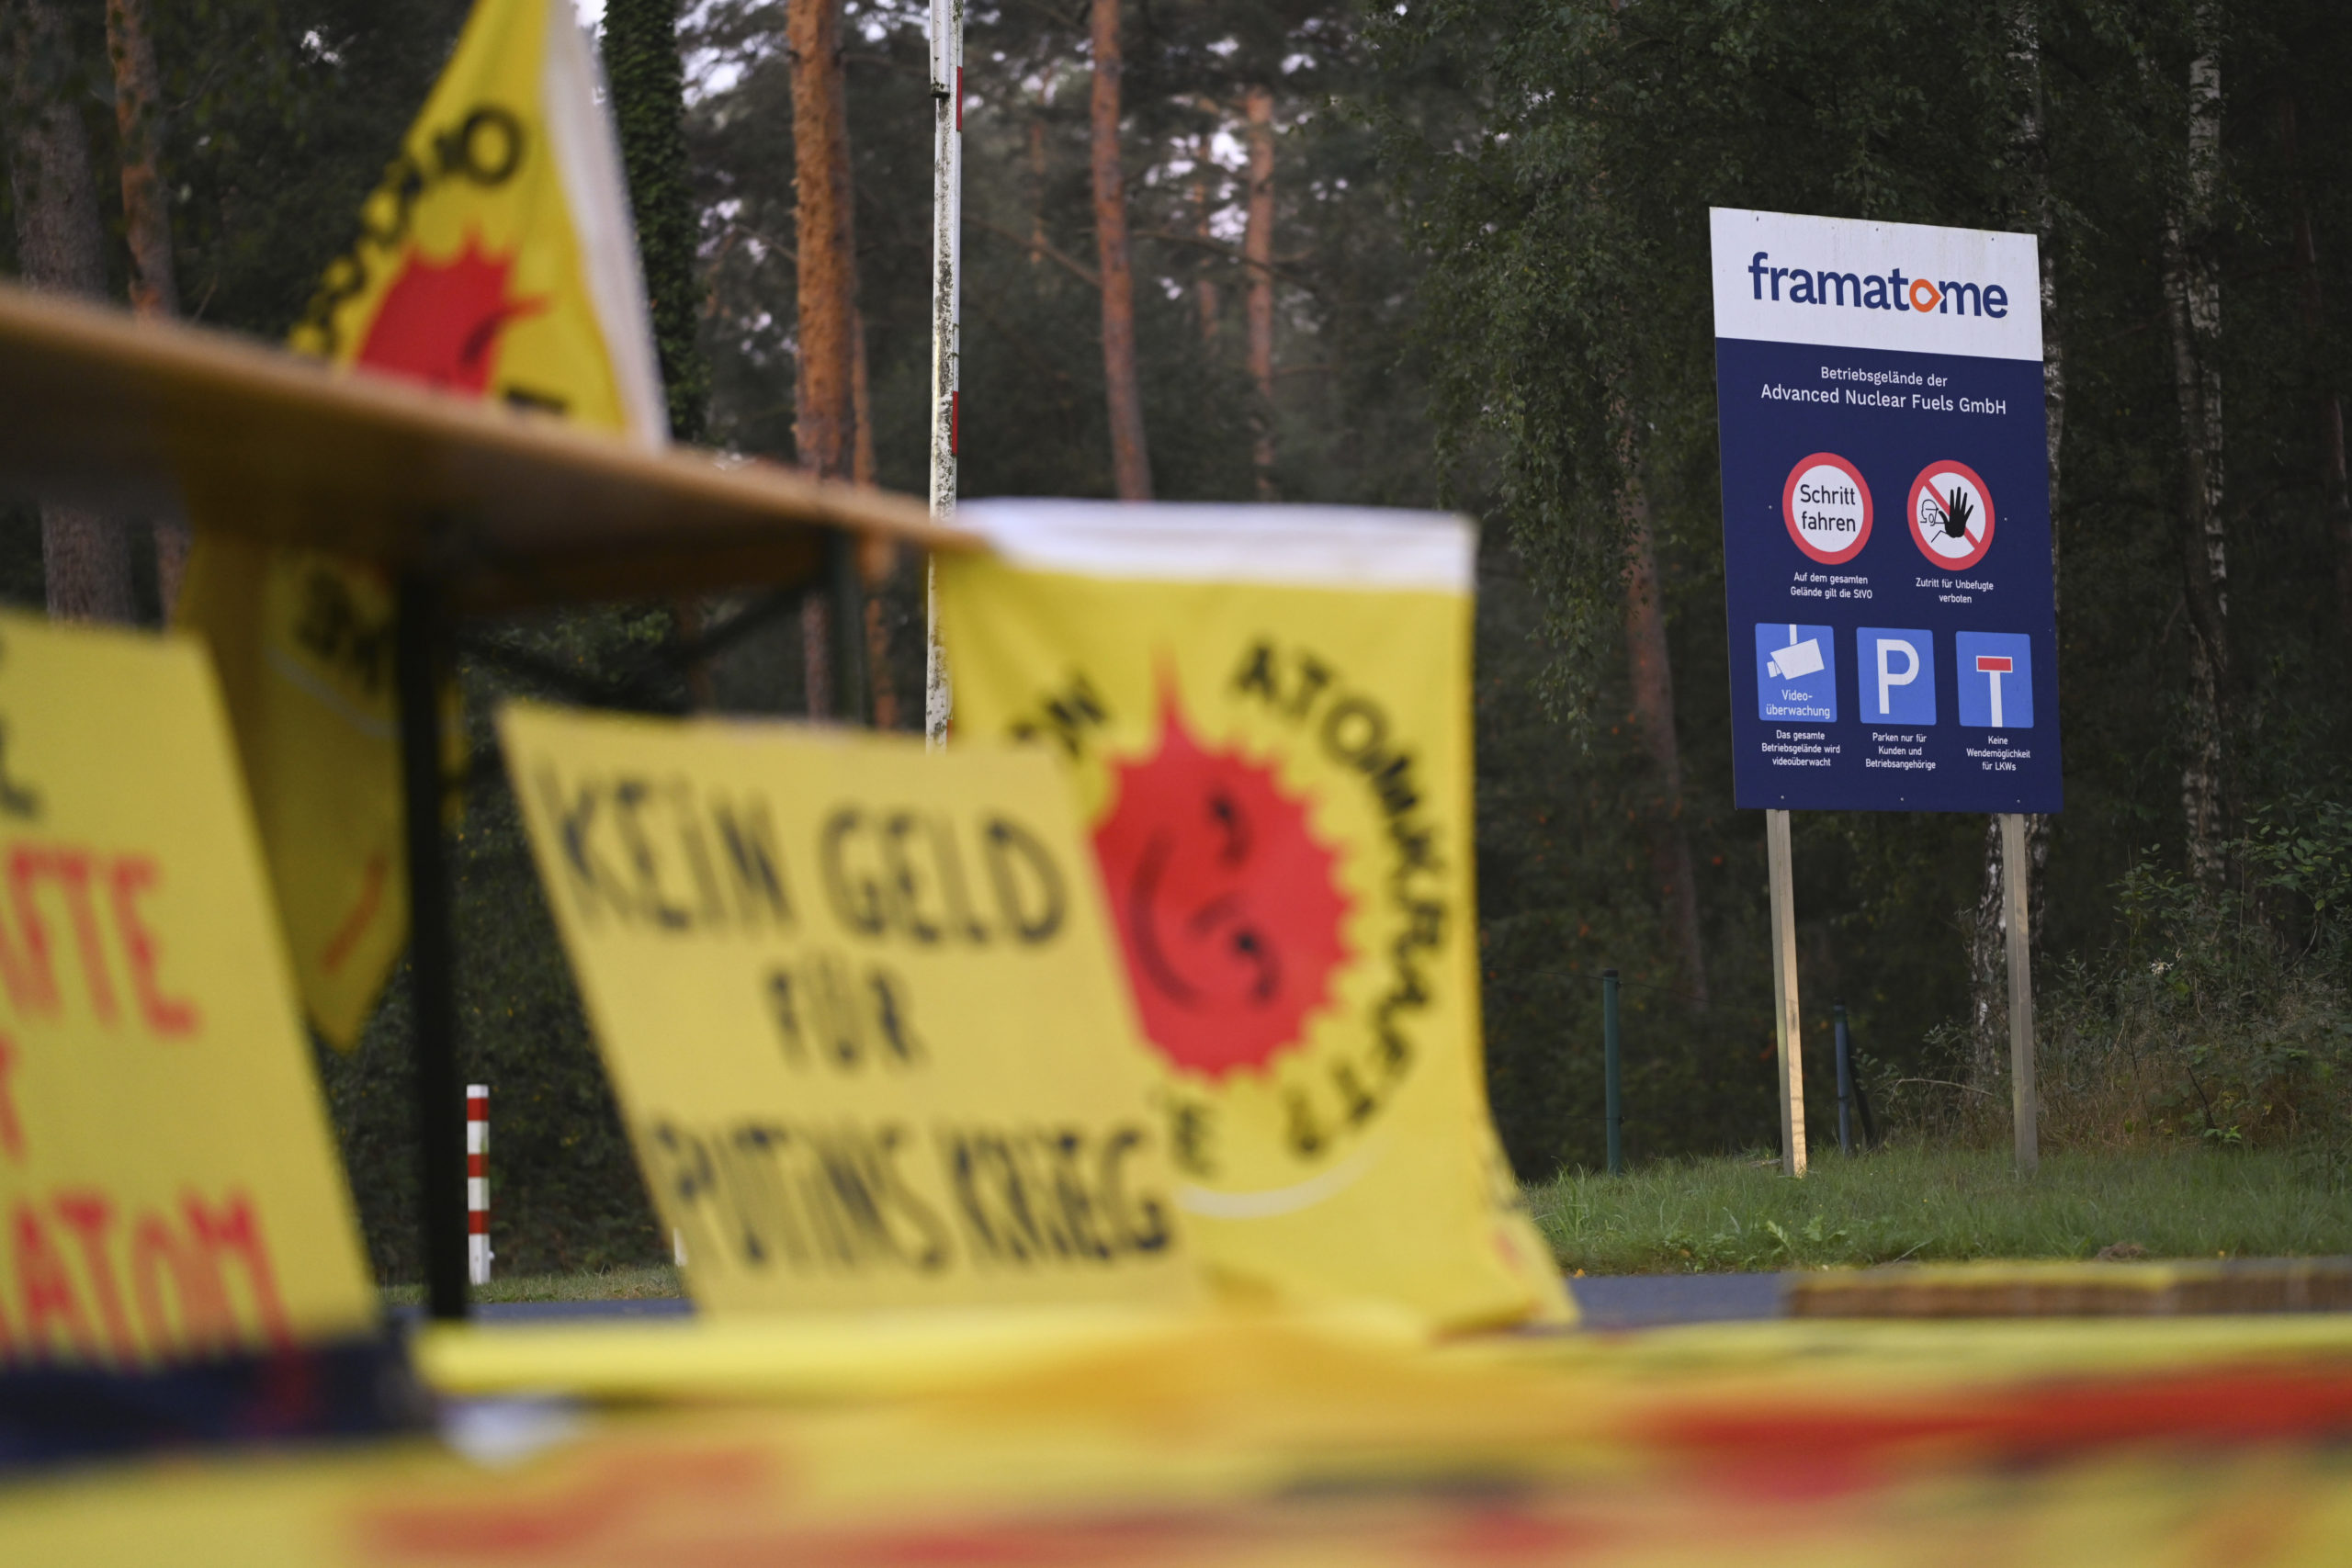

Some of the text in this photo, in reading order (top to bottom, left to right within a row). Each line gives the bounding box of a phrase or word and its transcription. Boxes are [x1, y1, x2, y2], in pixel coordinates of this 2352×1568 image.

[1747, 251, 2008, 319] framatome
[1820, 366, 1949, 388] Betriebsgelände der
[1760, 383, 2007, 415] Advanced Nuclear Fuels GmbH
[1800, 483, 1856, 505] Schritt
[1801, 511, 1857, 533] fahren
[1793, 571, 1869, 586] Auf dem gesamten
[1915, 577, 1995, 592] Zutritt für Unbefugte
[1790, 585, 1873, 600] Gelände gilt die StVO
[1939, 592, 1973, 604] verboten
[1876, 638, 1920, 715] P
[1781, 689, 1814, 702] Video-
[1766, 703, 1831, 720] überwachung
[1776, 729, 1826, 742] Das gesamte
[1871, 731, 1899, 742] Parken
[1916, 733, 1928, 743] für
[1987, 735, 2008, 745] Keine
[1761, 742, 1841, 755] Betriebsgelände wird
[1878, 745, 1923, 756] Kunden und
[1966, 748, 2030, 761] Wendemöglichkeit
[1771, 756, 1831, 767] videoüberwacht
[1865, 758, 1937, 772] Betriebsangehörige
[1982, 761, 2017, 772] für LKWs
[820, 804, 1068, 952] GELD
